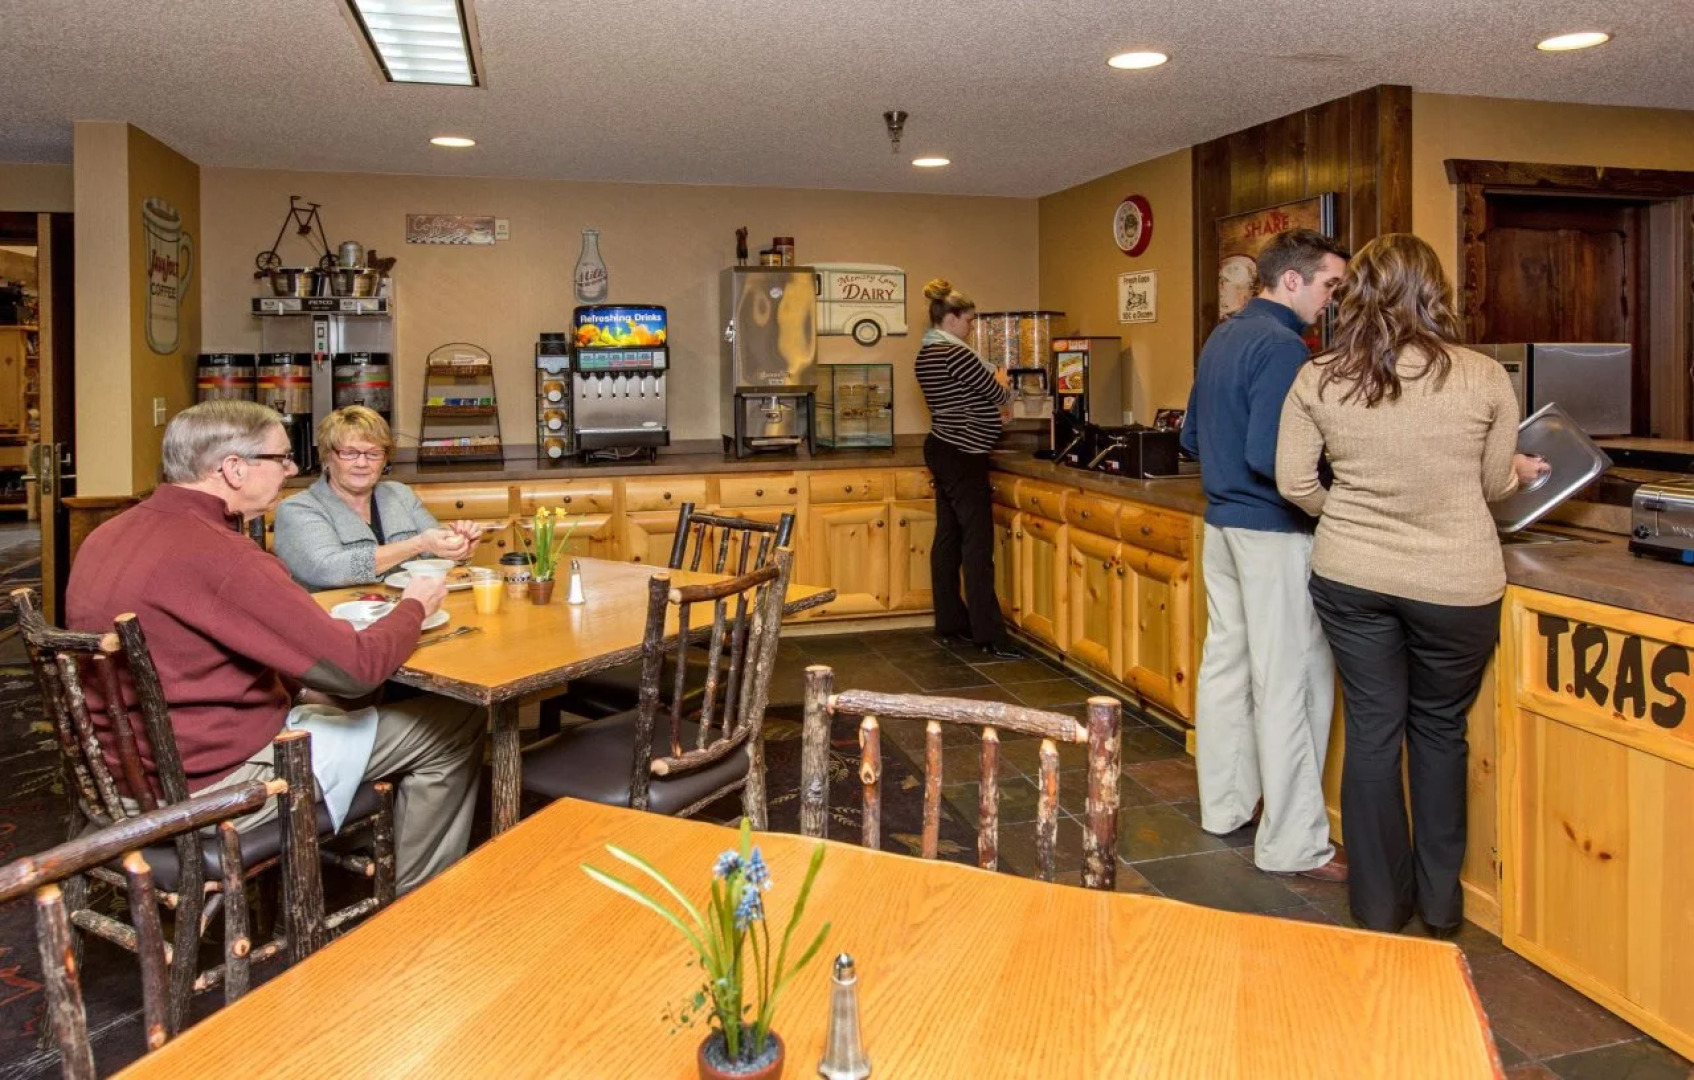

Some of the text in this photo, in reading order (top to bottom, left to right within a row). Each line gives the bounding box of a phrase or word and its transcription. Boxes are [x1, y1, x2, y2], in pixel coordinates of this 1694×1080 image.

[1244, 214, 1289, 238] SHARE
[151, 282, 176, 299] COFFEE
[842, 283, 894, 301] DAIRY
[580, 312, 662, 324] Refreshing Drinks
[1538, 613, 1690, 729] TRAS
